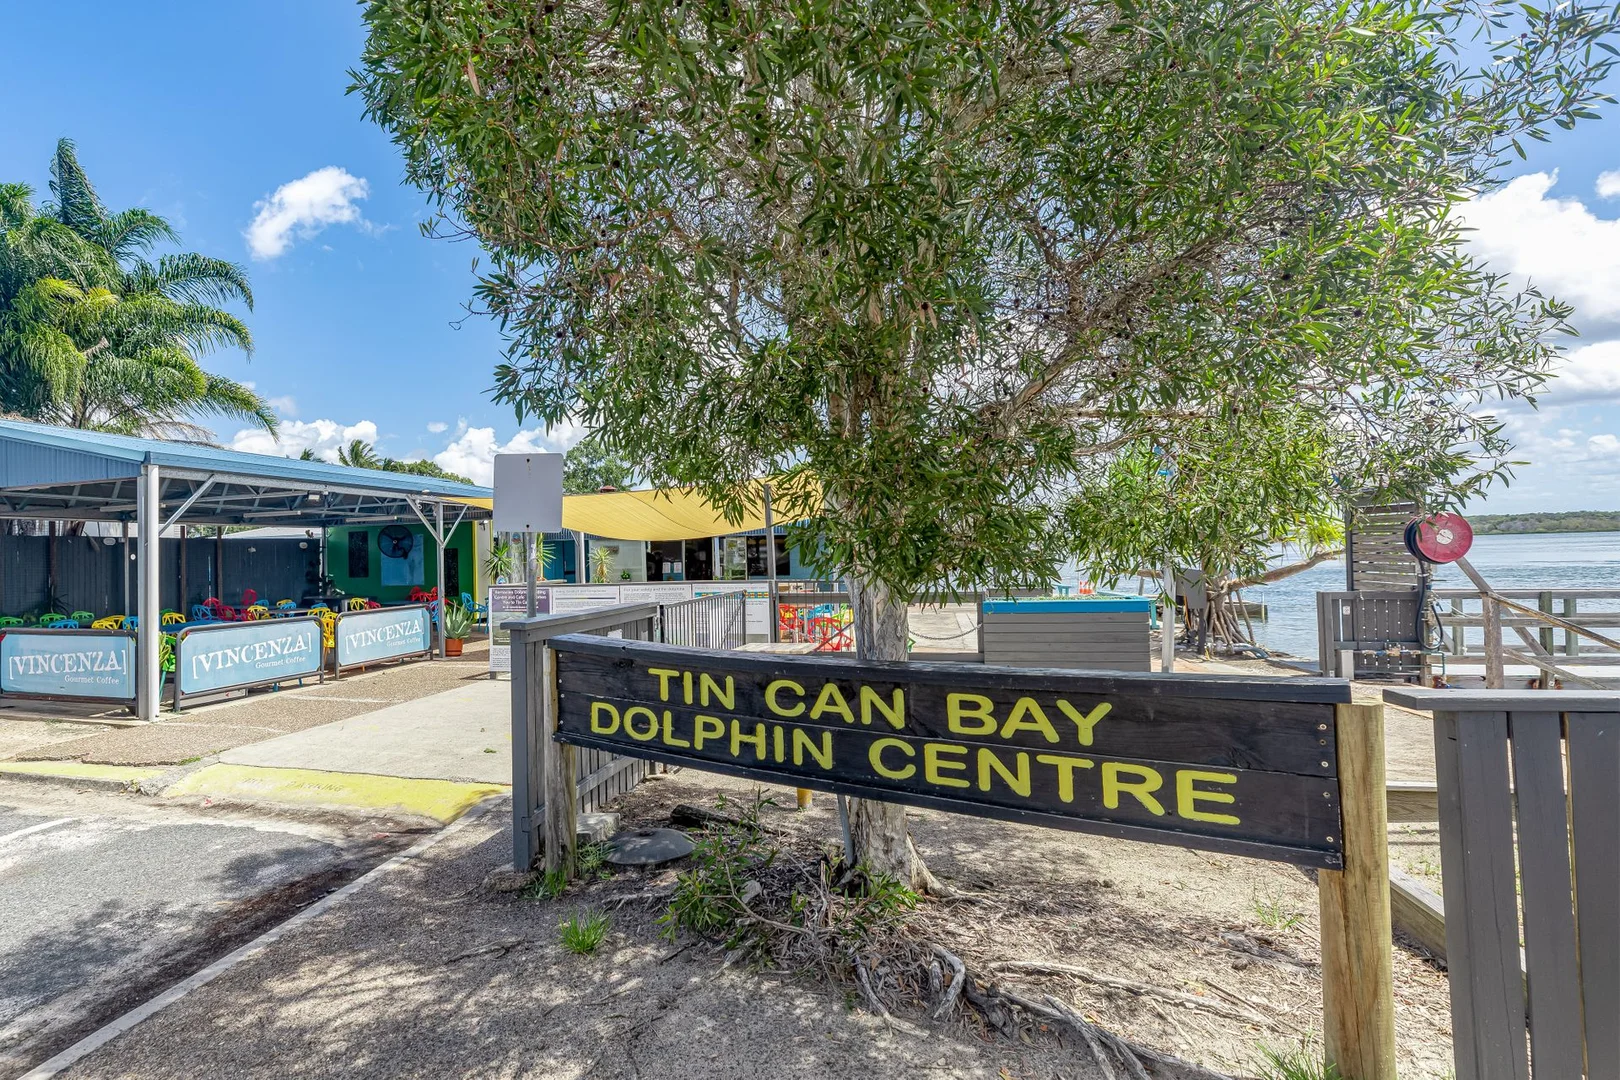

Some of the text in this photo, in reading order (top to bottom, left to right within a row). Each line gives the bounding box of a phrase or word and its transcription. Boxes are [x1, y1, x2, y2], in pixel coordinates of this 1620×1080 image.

[64, 674, 120, 685] Gourmet Coffee
[255, 656, 306, 669] Gourmet Coffee
[648, 667, 1112, 747] TIN CAN BAY
[590, 701, 1241, 825] DOLPHIN CENTRE
